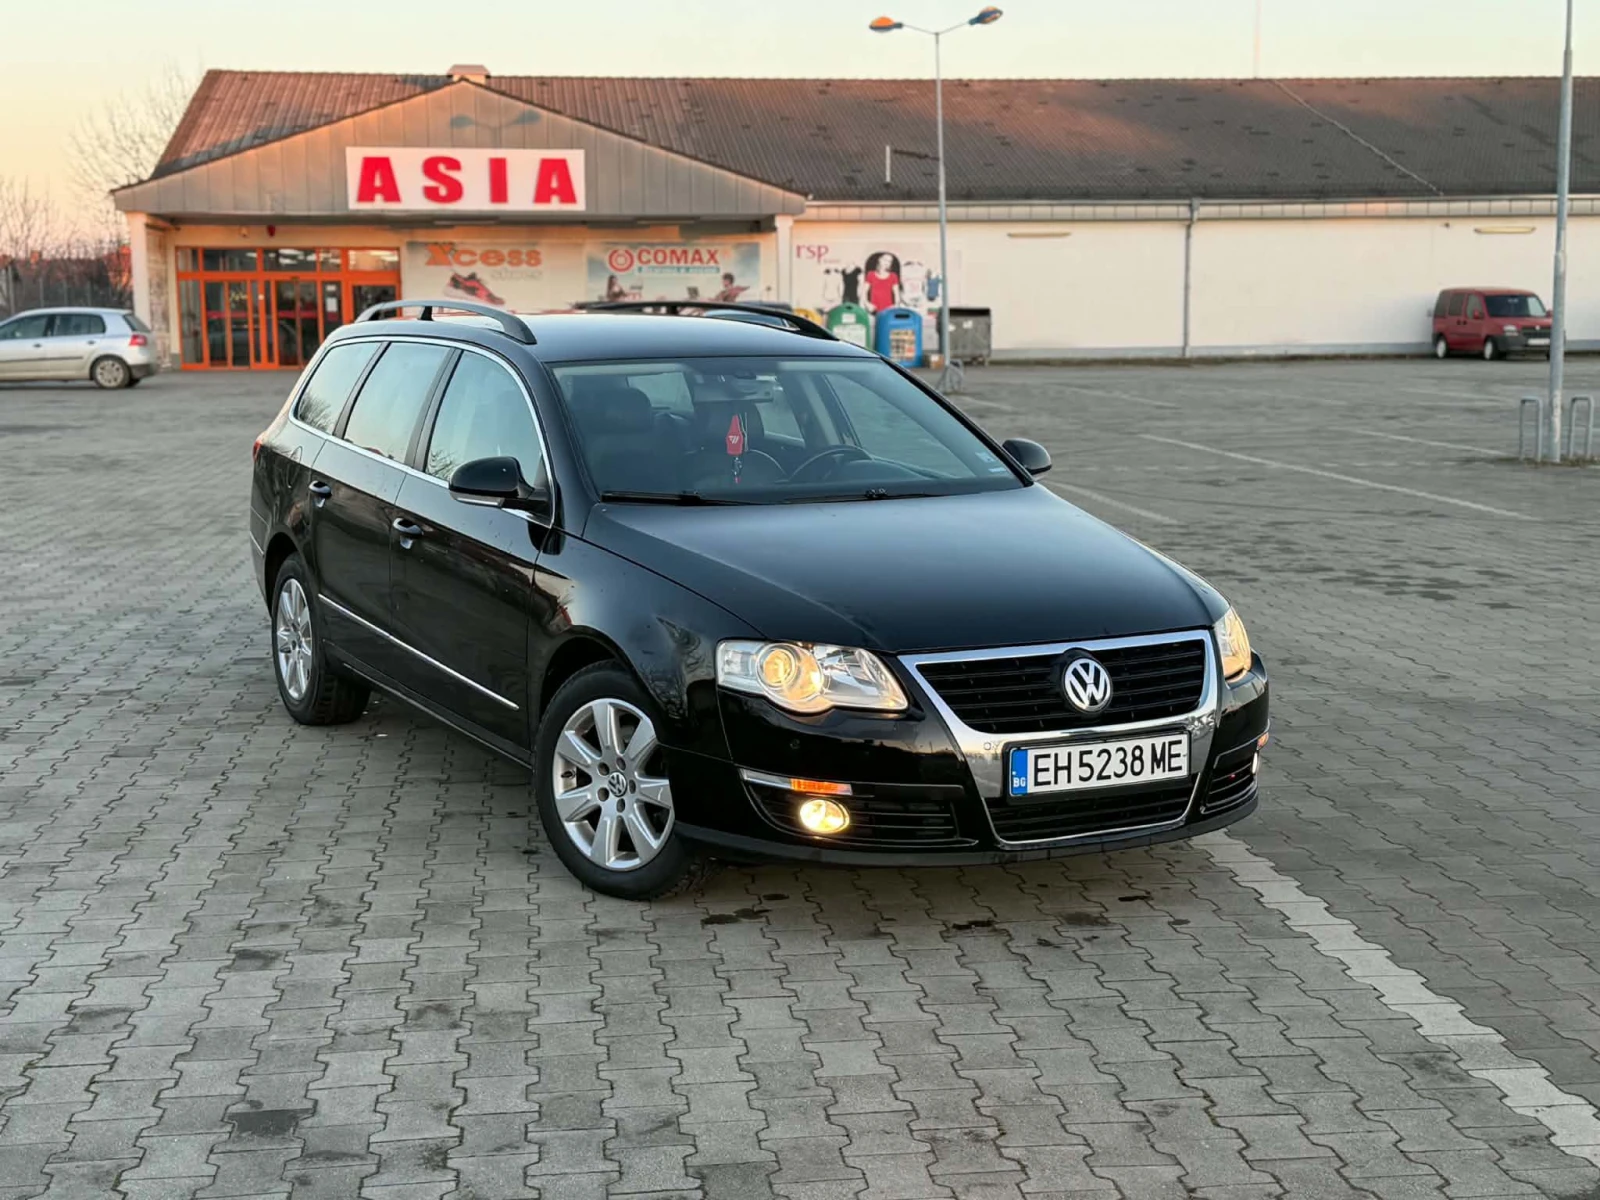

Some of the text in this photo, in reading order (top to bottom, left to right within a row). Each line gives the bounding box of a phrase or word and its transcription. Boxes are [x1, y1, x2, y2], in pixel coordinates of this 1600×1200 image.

[357, 156, 577, 204] ASIA
[425, 243, 541, 267] Xcess
[637, 249, 719, 265] COMAX
[796, 244, 829, 264] rsp
[1013, 777, 1026, 788] BG
